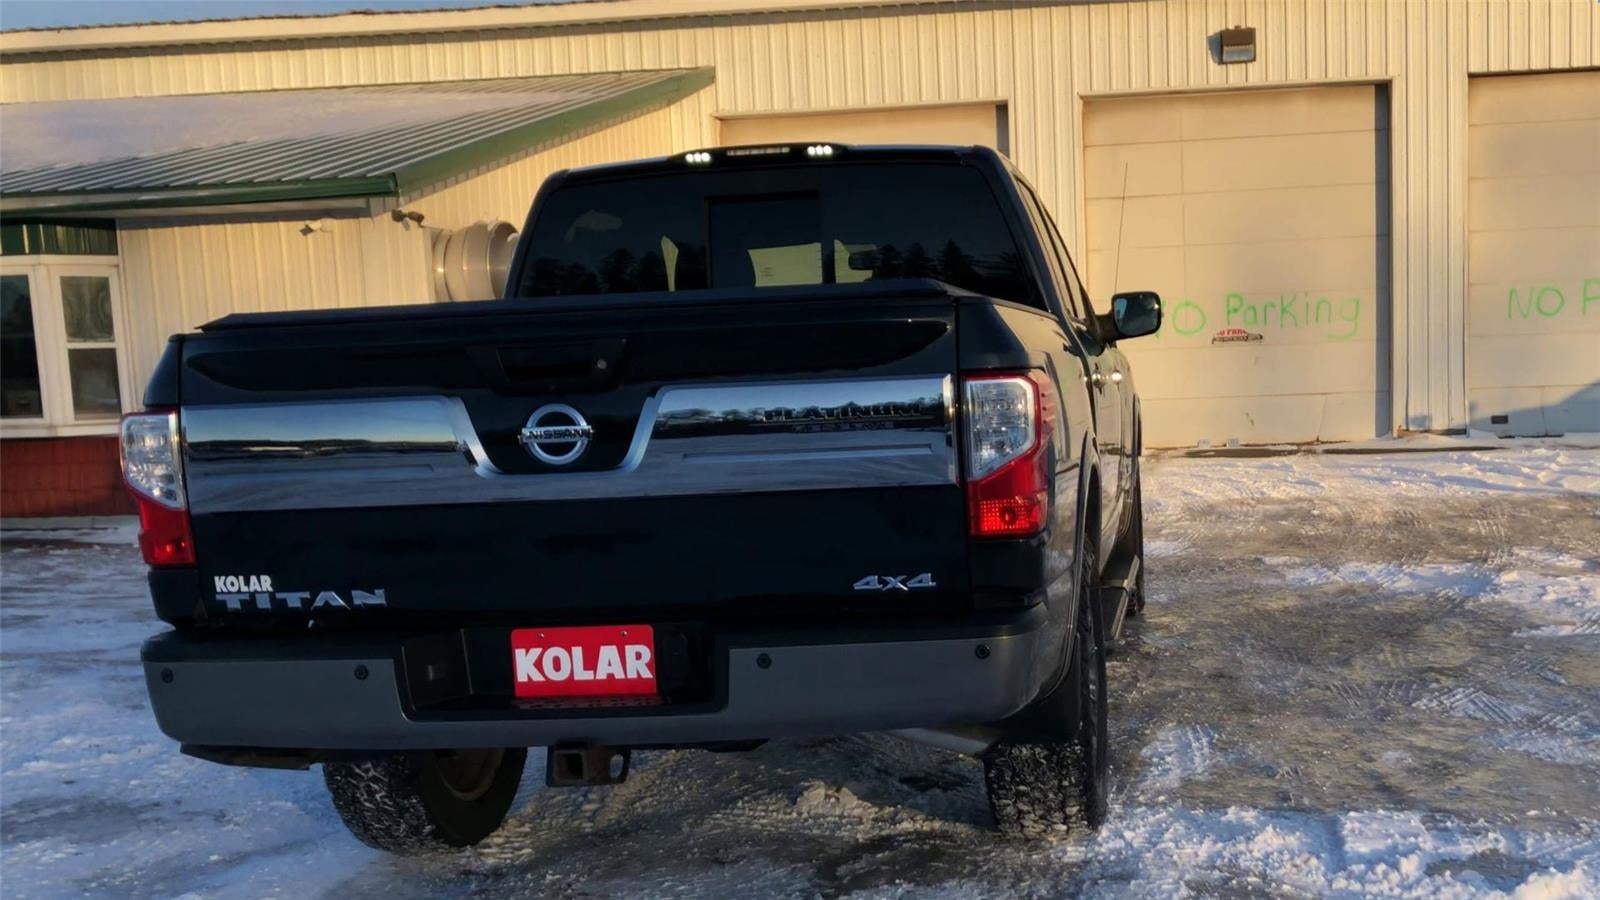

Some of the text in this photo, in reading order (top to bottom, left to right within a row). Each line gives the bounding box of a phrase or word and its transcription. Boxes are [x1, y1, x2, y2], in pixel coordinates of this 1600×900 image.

[1507, 285, 1565, 320] NO
[524, 427, 592, 441] NISSAN
[214, 574, 273, 593] KOLAR
[215, 588, 388, 610] TITAN
[514, 644, 654, 683] KOLAR
